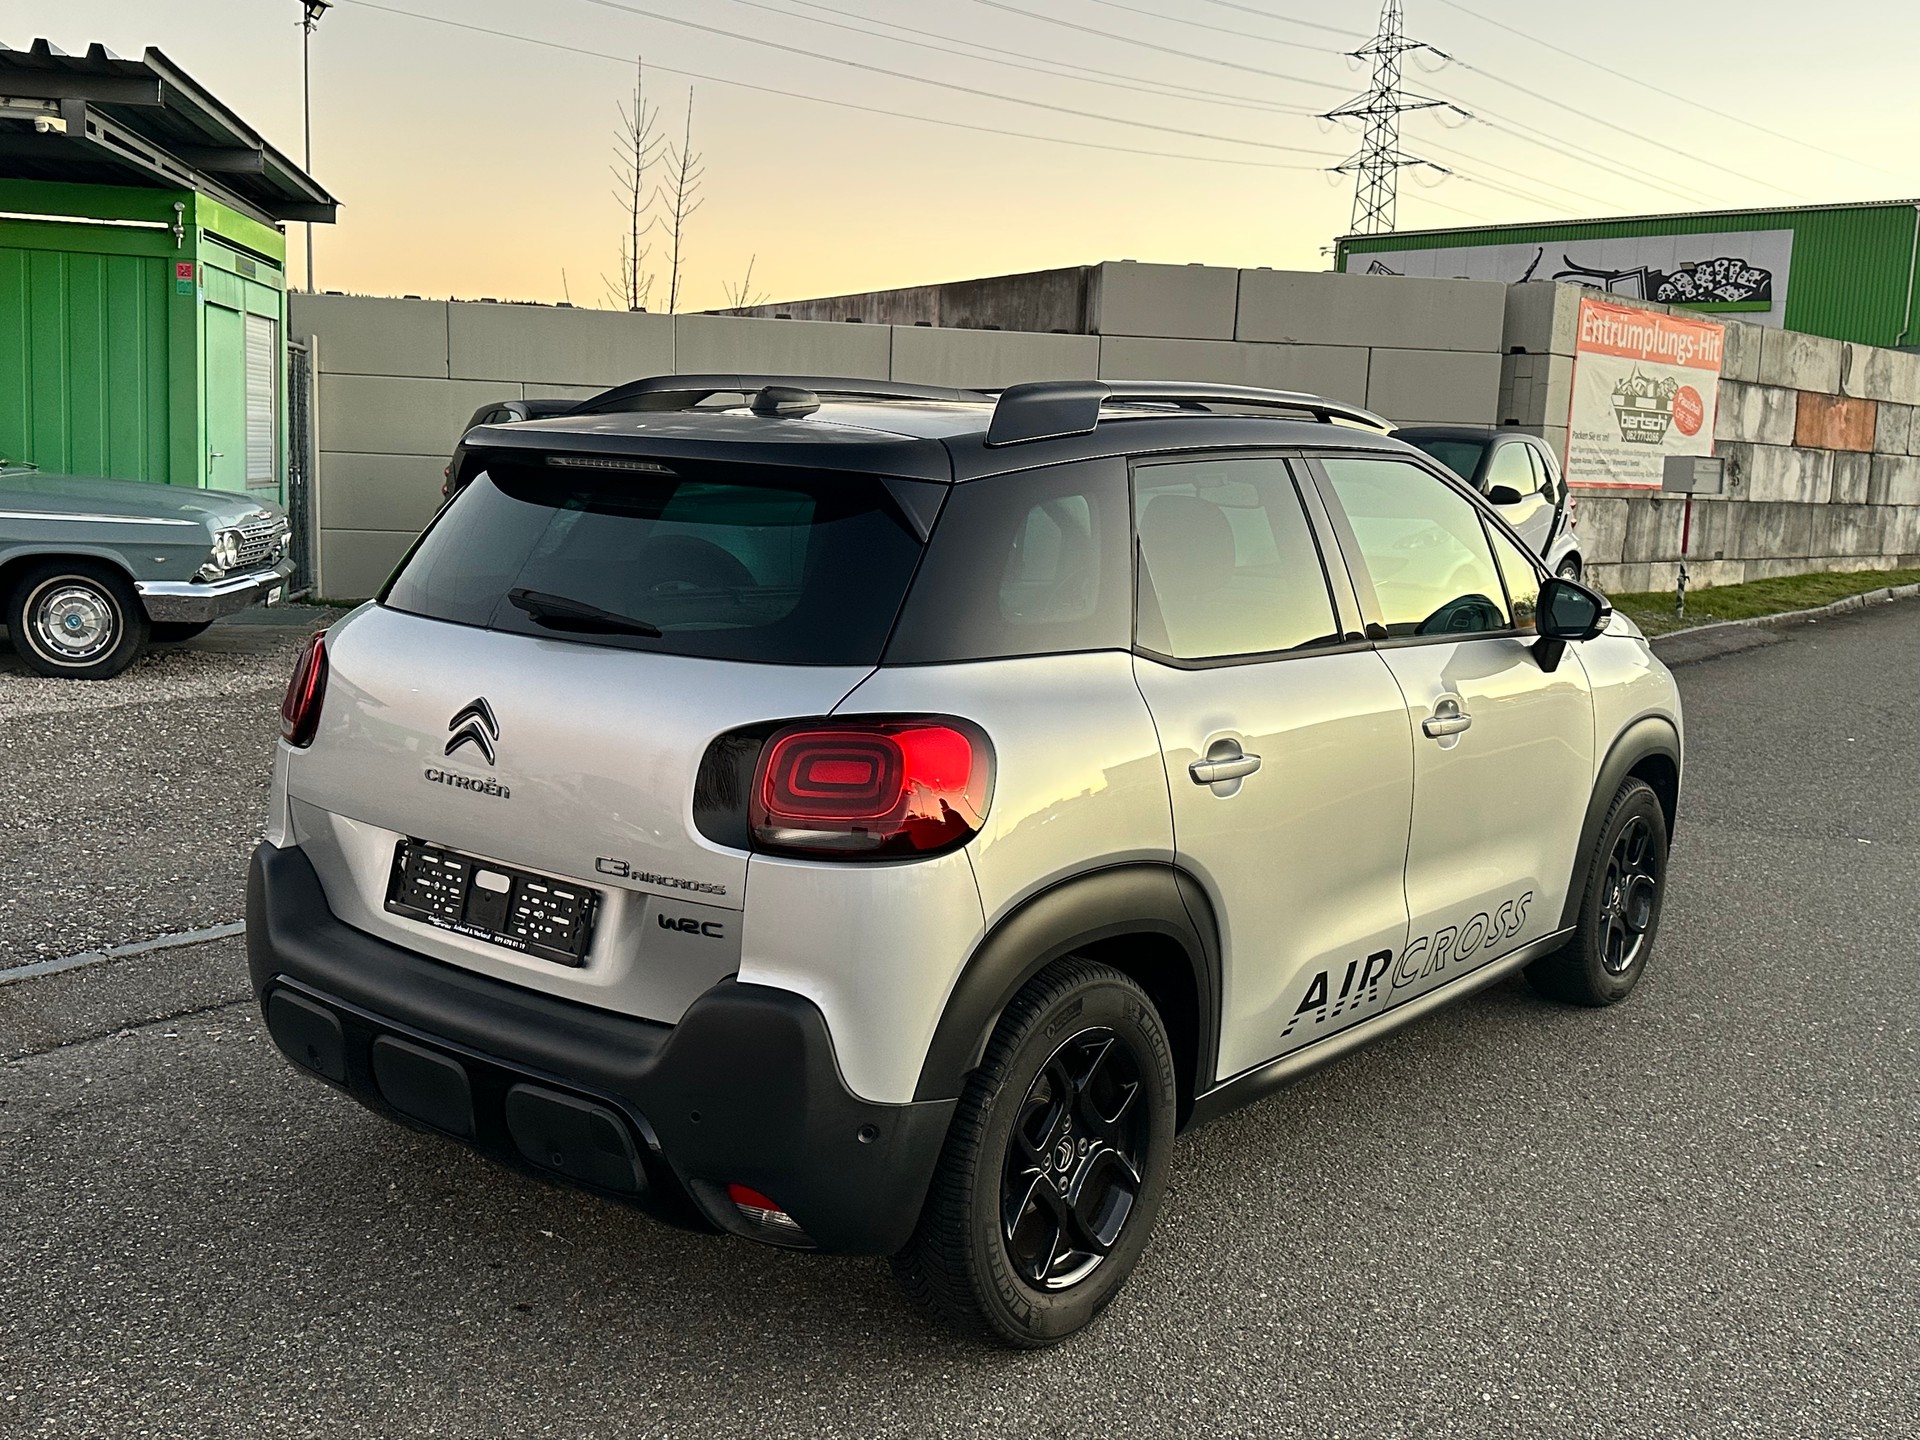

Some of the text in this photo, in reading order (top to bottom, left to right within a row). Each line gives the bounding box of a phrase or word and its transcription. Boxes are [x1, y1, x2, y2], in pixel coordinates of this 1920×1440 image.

[1581, 308, 1720, 365] Entrümplungs-Hit
[1621, 411, 1668, 431] bertschi
[631, 870, 727, 895] AIRCROSS
[657, 913, 724, 939] WRC
[1140, 1012, 1172, 1102] MICHELIN
